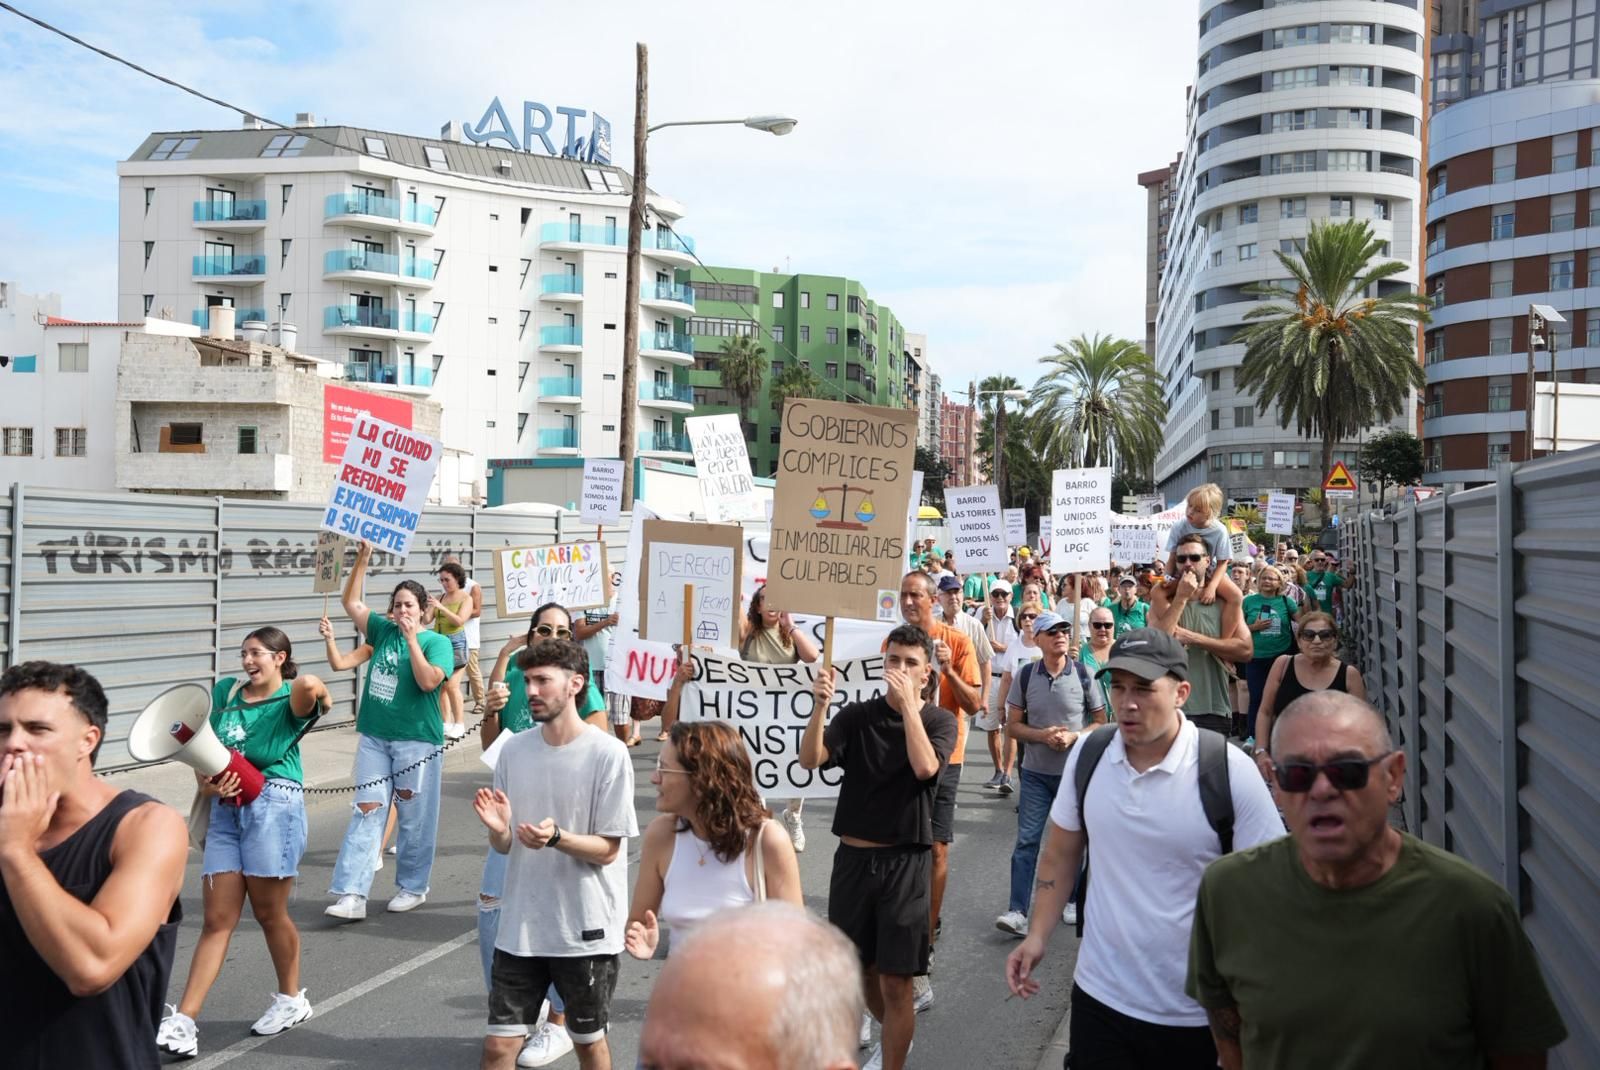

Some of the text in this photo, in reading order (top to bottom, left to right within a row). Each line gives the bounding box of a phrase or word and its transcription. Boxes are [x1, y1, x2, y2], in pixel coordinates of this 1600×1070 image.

[463, 96, 587, 158] ART
[357, 420, 380, 443] LA
[787, 403, 908, 448] GOBIERNOS
[361, 446, 409, 478] NO SE
[592, 466, 615, 474] BARRIO
[782, 448, 899, 482] CÓMPLICES
[340, 463, 407, 502] REFORMA
[1065, 480, 1098, 490] BARRIO
[334, 486, 418, 531] EXPULSANDO
[590, 503, 607, 511] LPGC
[956, 495, 986, 505] BARRIO
[1056, 495, 1106, 506] LAS TORRES
[951, 508, 996, 519] LAS TORRES
[1063, 511, 1097, 521] UNIDOS
[325, 507, 338, 526] A
[340, 513, 360, 534] SU
[360, 520, 406, 552] GENTE
[960, 522, 990, 531] UNIDOS
[1055, 527, 1085, 536] SOMOS
[1086, 525, 1104, 535] MÁS
[774, 528, 903, 559] INMOBILIARIAS
[955, 534, 999, 543] SOMOS MÁS
[1064, 542, 1090, 553] LPGC
[658, 551, 731, 577] DERECHO
[965, 548, 989, 558] LPGC
[506, 571, 527, 589] se
[538, 565, 573, 585] ama
[780, 558, 877, 586] CULPABLES
[656, 586, 730, 612] A TECHO
